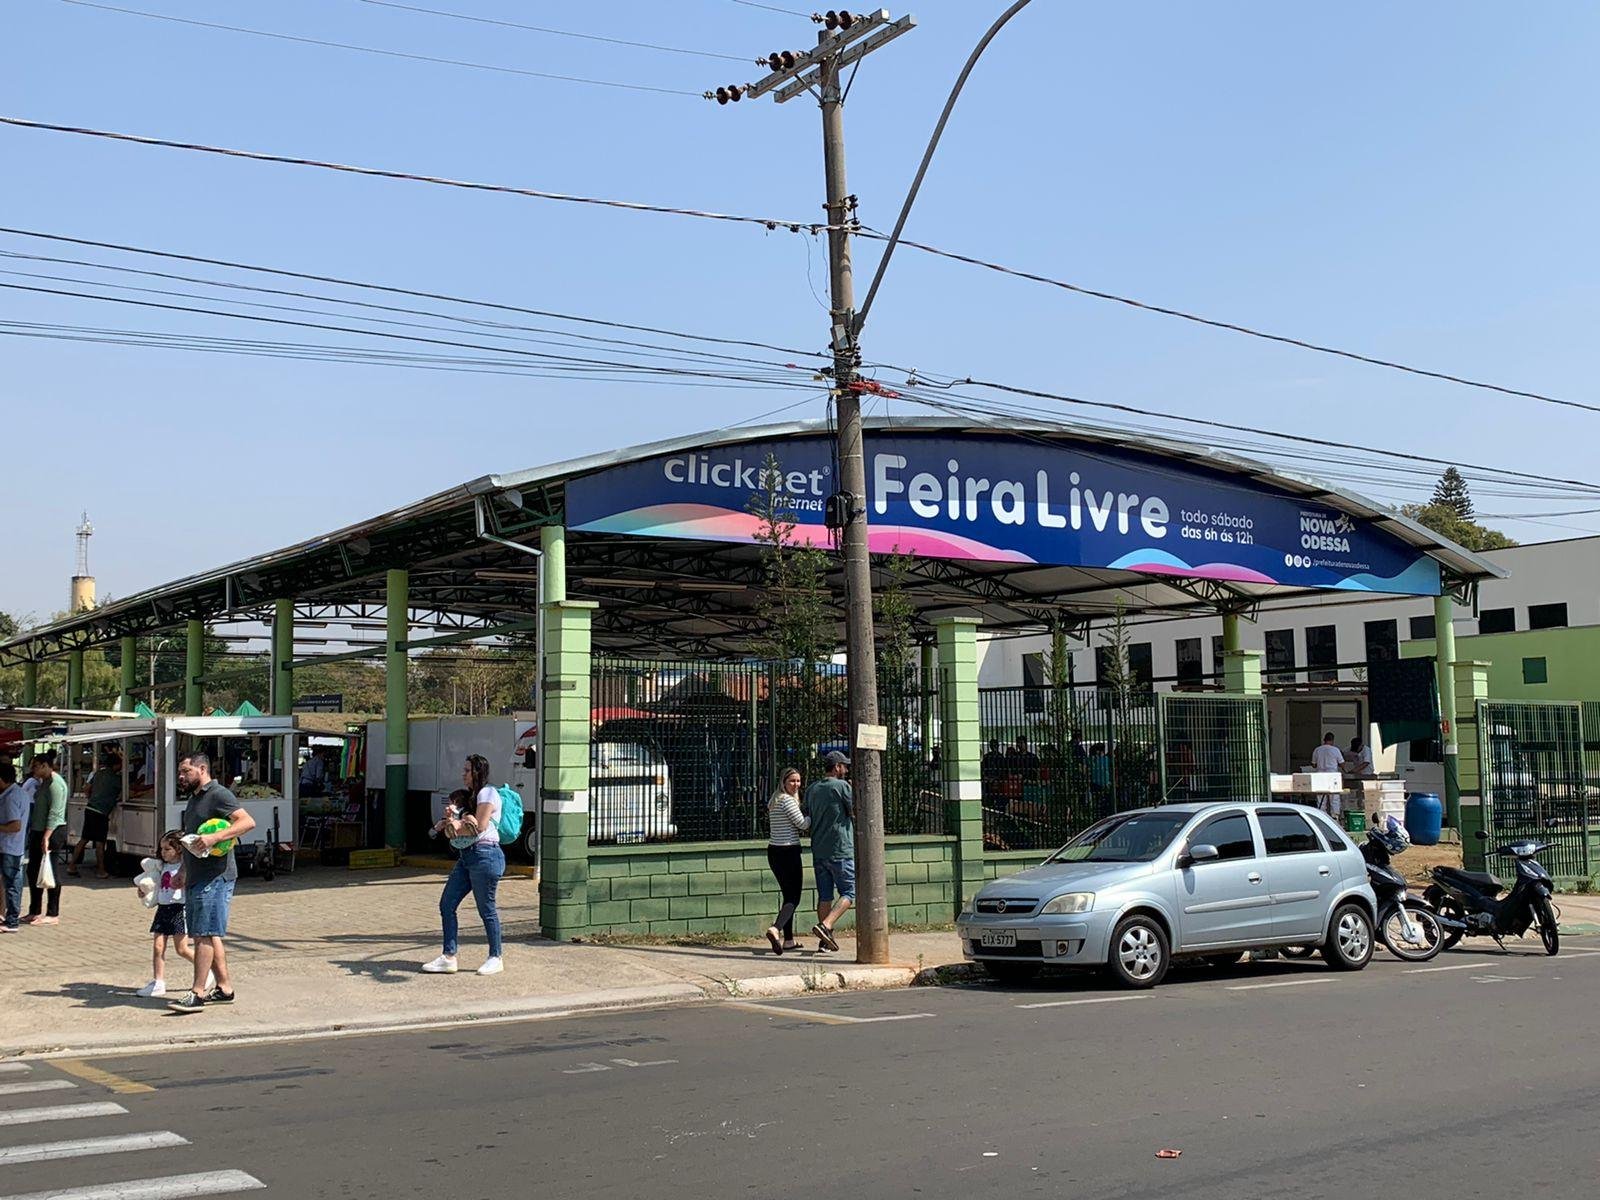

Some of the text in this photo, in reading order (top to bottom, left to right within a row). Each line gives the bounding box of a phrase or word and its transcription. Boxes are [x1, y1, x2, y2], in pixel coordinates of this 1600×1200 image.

[874, 453, 1170, 538] Feira Livre
[1181, 509, 1253, 529] todo sábado
[1300, 517, 1336, 534] NOVA
[1181, 525, 1202, 539] das
[1204, 528, 1218, 540] 6h
[1235, 531, 1254, 545] 12h
[1301, 534, 1350, 552] ODESSA
